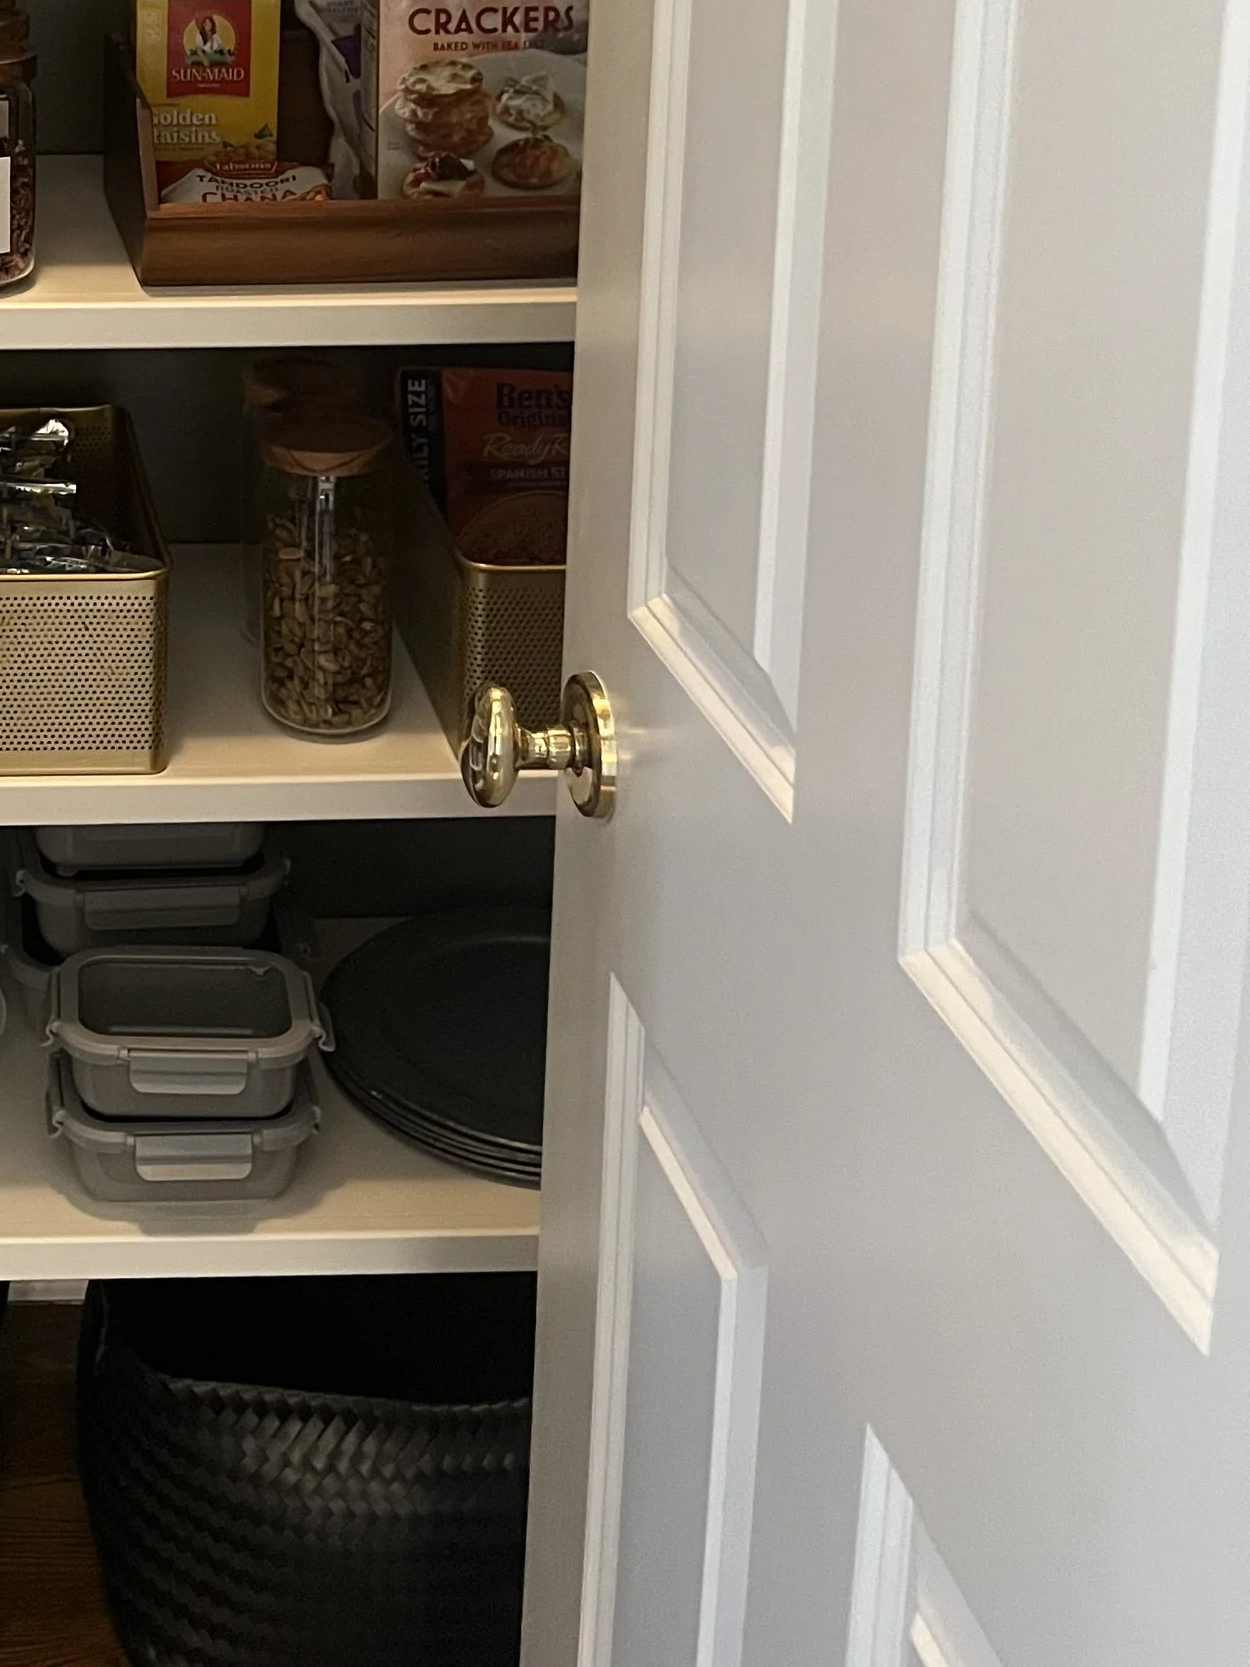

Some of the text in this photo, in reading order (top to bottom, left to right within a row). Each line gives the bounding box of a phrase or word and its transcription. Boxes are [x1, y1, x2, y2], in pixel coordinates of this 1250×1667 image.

[407, 4, 575, 36] CRACKERS
[432, 40, 469, 52] BAKED
[471, 40, 499, 51] WITH
[500, 40, 520, 51] SEA
[196, 173, 297, 190] TANDOORI
[201, 189, 297, 203] CHANA
[407, 378, 427, 428] SIZE
[496, 381, 572, 411] Ben's
[482, 432, 548, 466] Ready
[489, 466, 548, 480] SPANISH
